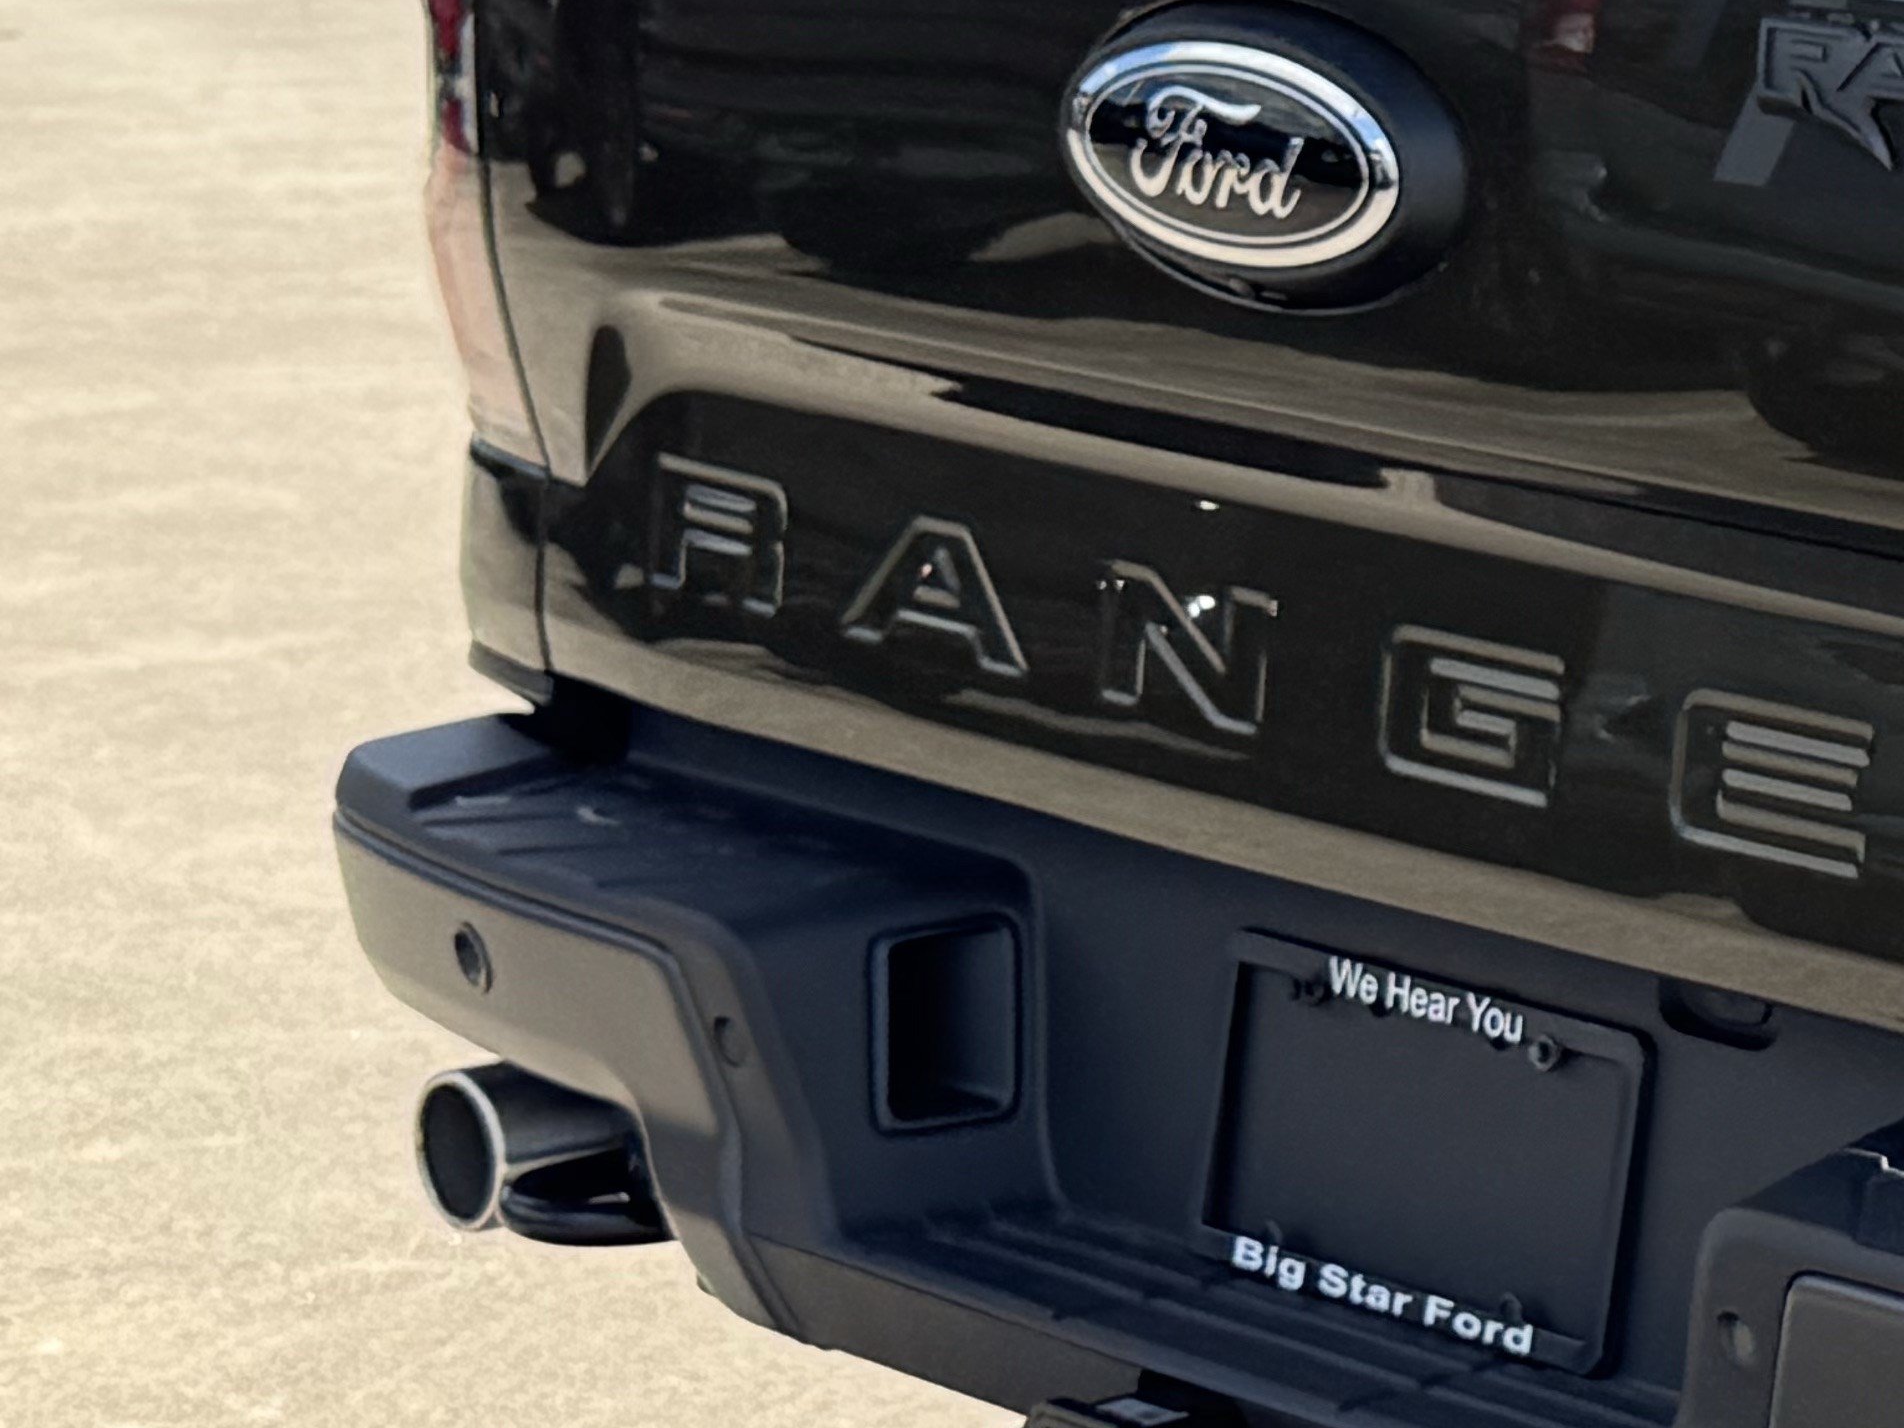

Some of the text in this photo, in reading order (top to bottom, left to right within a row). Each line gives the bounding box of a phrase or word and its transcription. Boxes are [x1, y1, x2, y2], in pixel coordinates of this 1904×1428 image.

[1130, 84, 1305, 220] Ford
[1329, 955, 1523, 1044] We Hear You
[1231, 1235, 1534, 1356] Big Star Ford
